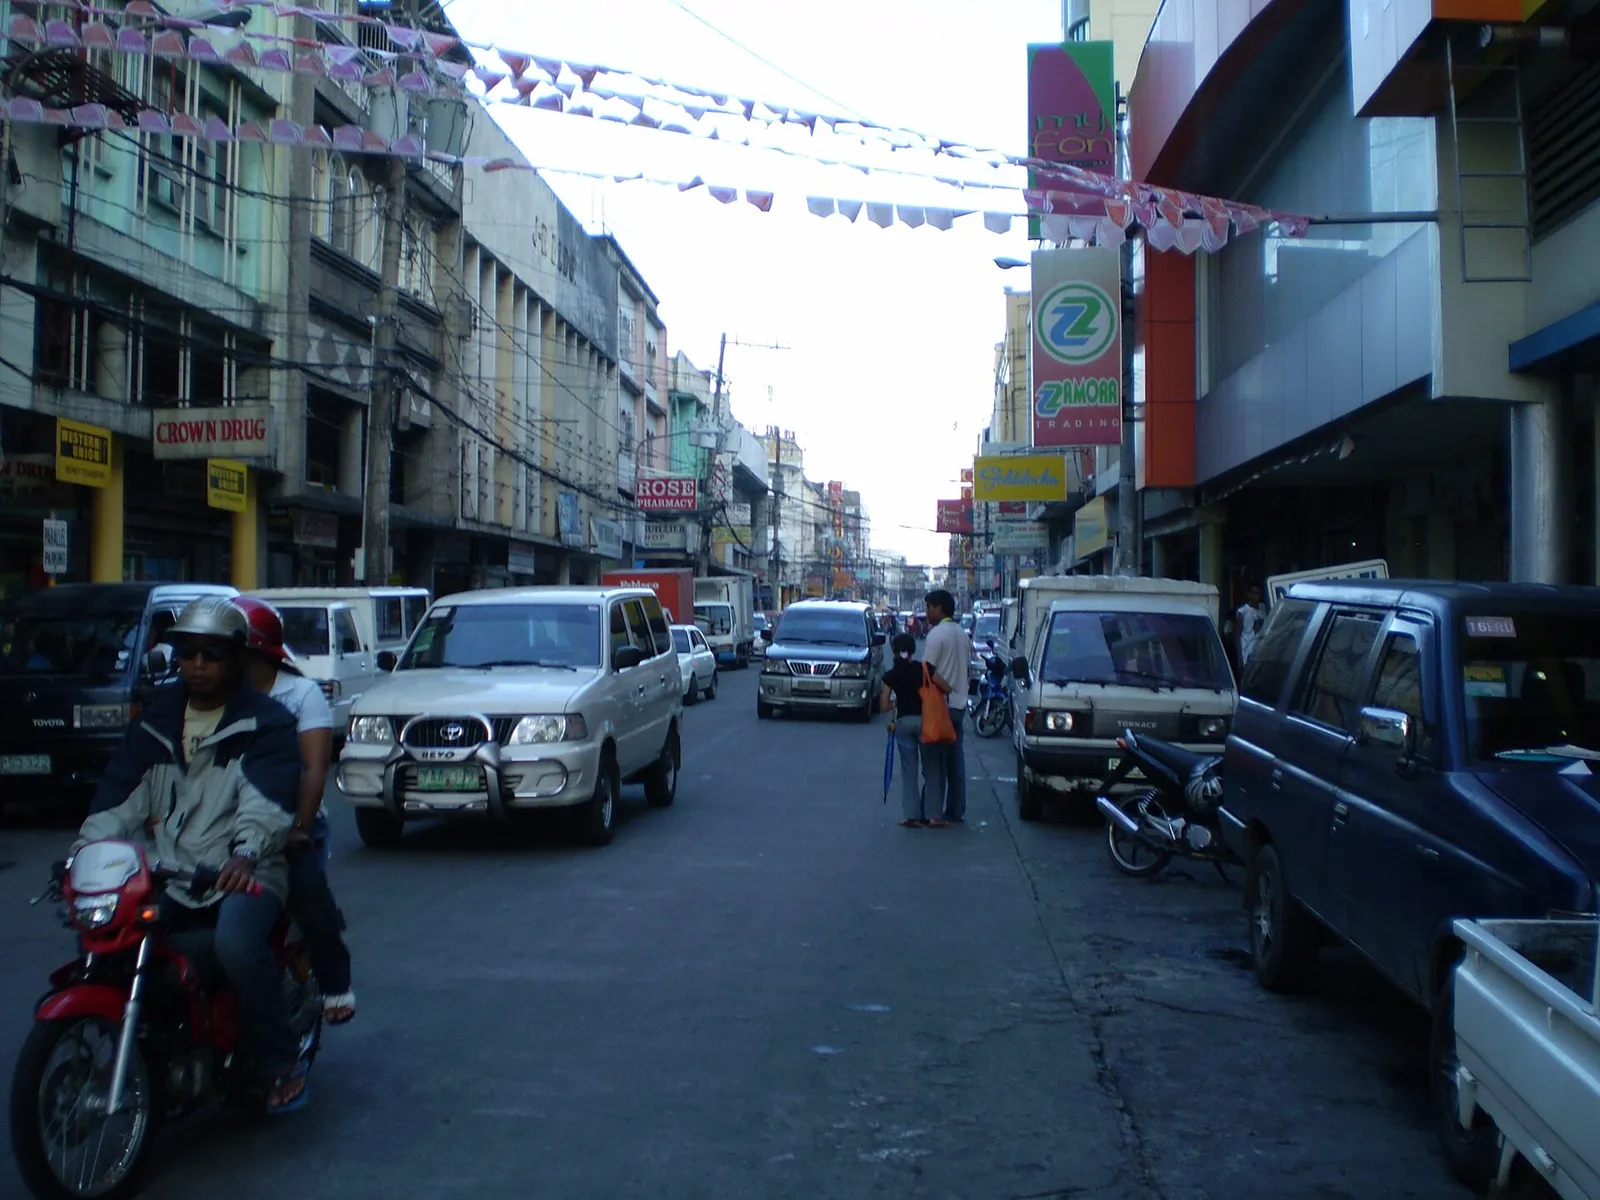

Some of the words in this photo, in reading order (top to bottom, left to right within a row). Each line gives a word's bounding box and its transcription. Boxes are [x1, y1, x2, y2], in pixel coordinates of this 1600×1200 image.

[1036, 110, 1108, 136] my
[1031, 131, 1113, 157] fon
[1035, 377, 1119, 418] ZAMORA
[156, 421, 216, 445] CROWN
[219, 418, 266, 442] DRUG
[1036, 419, 1119, 428] TRADING
[61, 430, 100, 450] WESTERN
[73, 446, 100, 462] UNION
[638, 481, 695, 496] ROSE
[637, 499, 694, 508] PHARMACY
[33, 719, 65, 727] TOYOTA
[421, 751, 455, 759] REVO
